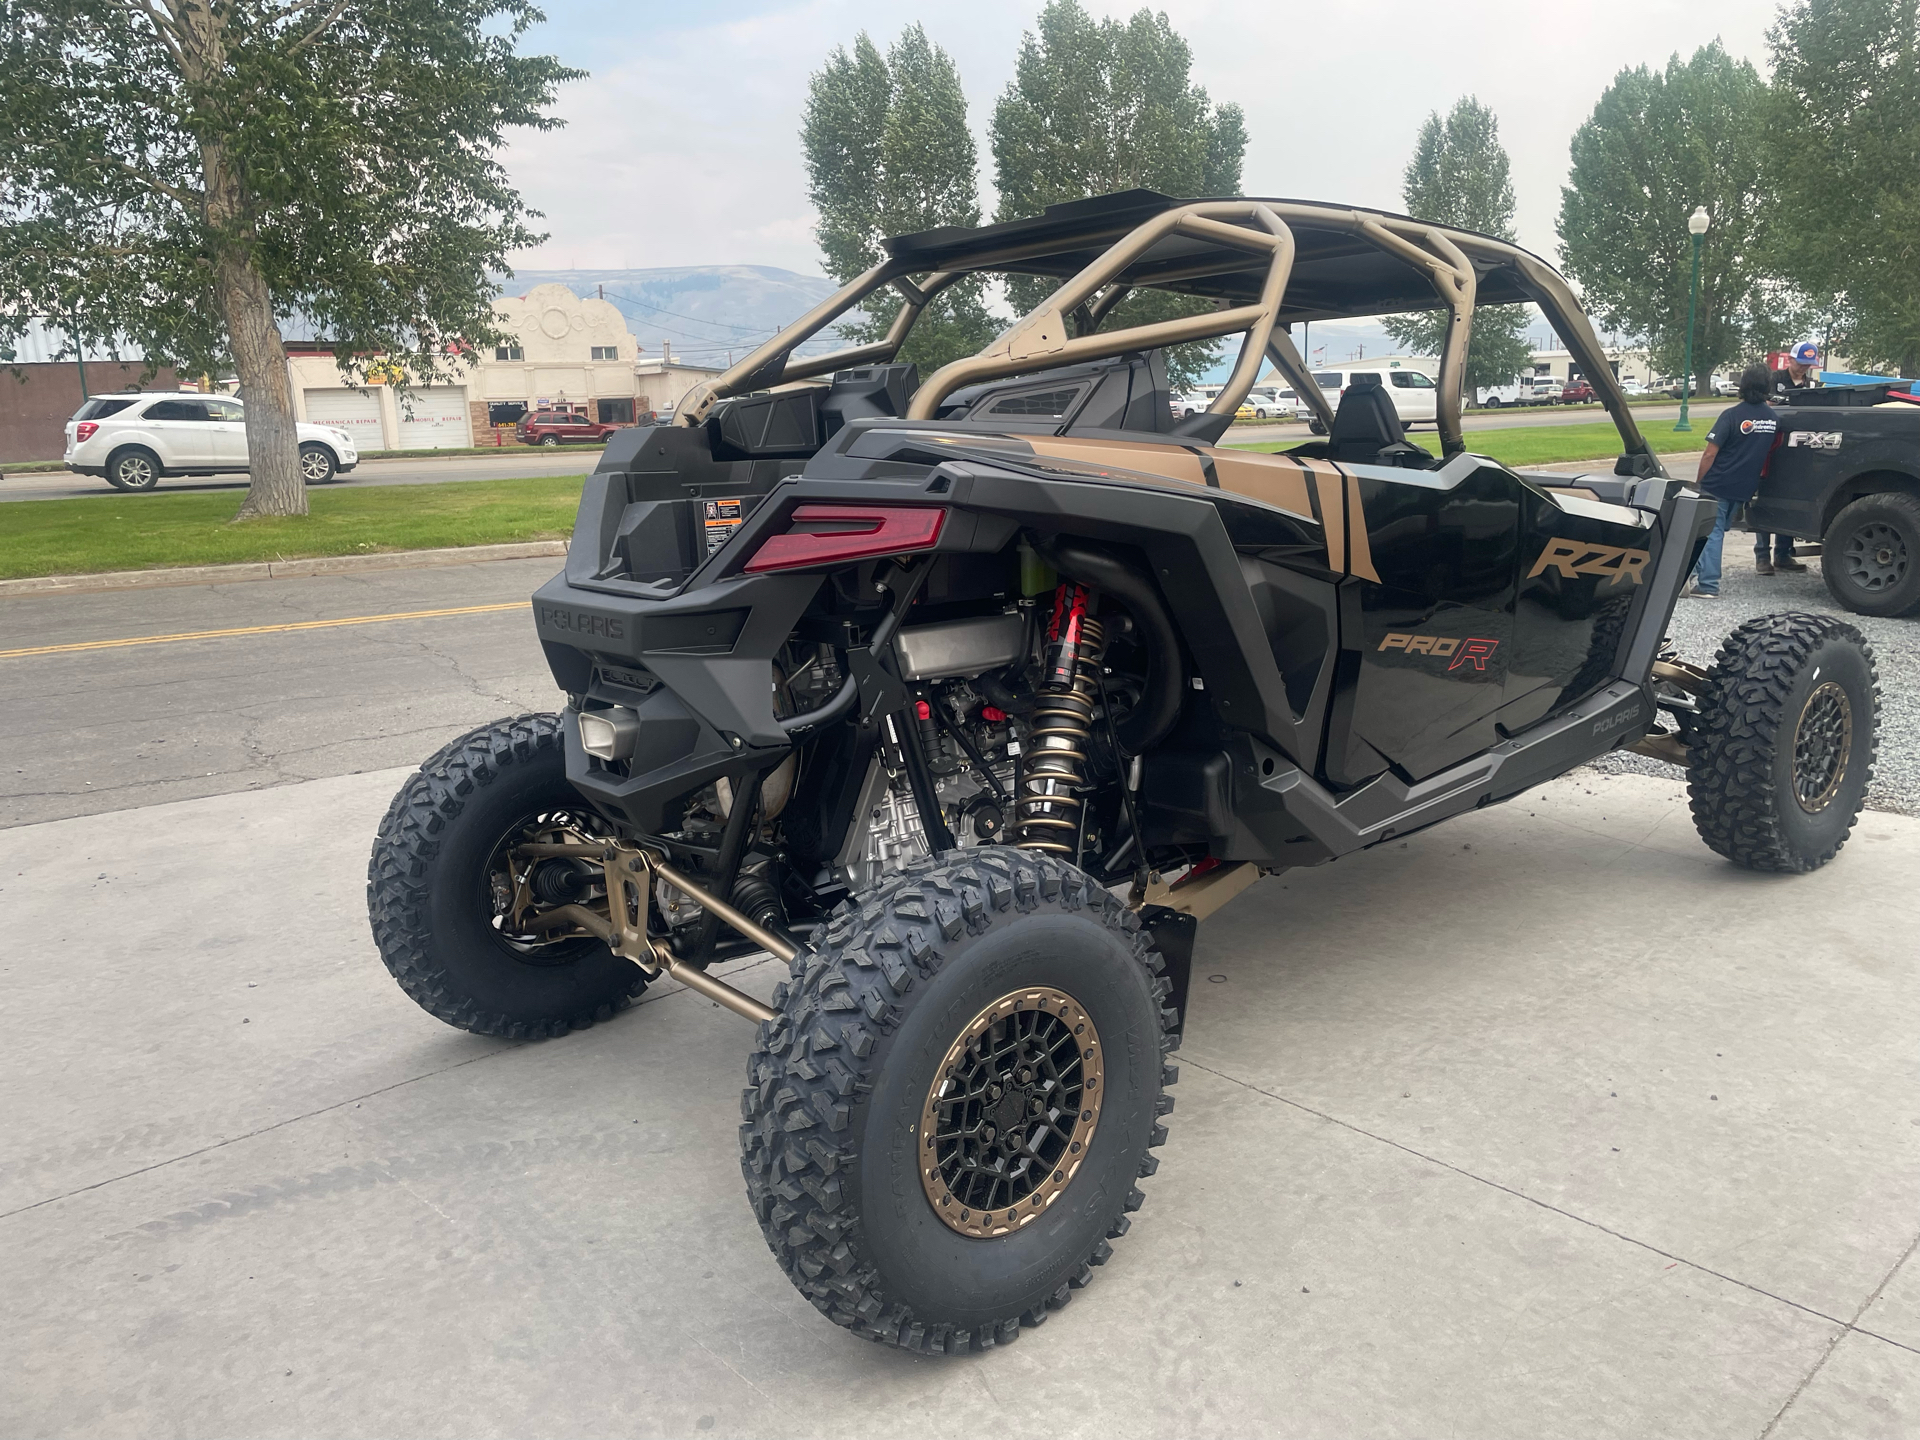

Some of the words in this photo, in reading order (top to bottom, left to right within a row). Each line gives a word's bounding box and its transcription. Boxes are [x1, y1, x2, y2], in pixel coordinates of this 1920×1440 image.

[1788, 431, 1843, 449] FX4
[1526, 536, 1651, 586] RZR
[541, 606, 624, 640] POLARIS
[1377, 633, 1461, 657] PRO
[1448, 638, 1499, 671] R
[1592, 704, 1640, 737] POLARIS
